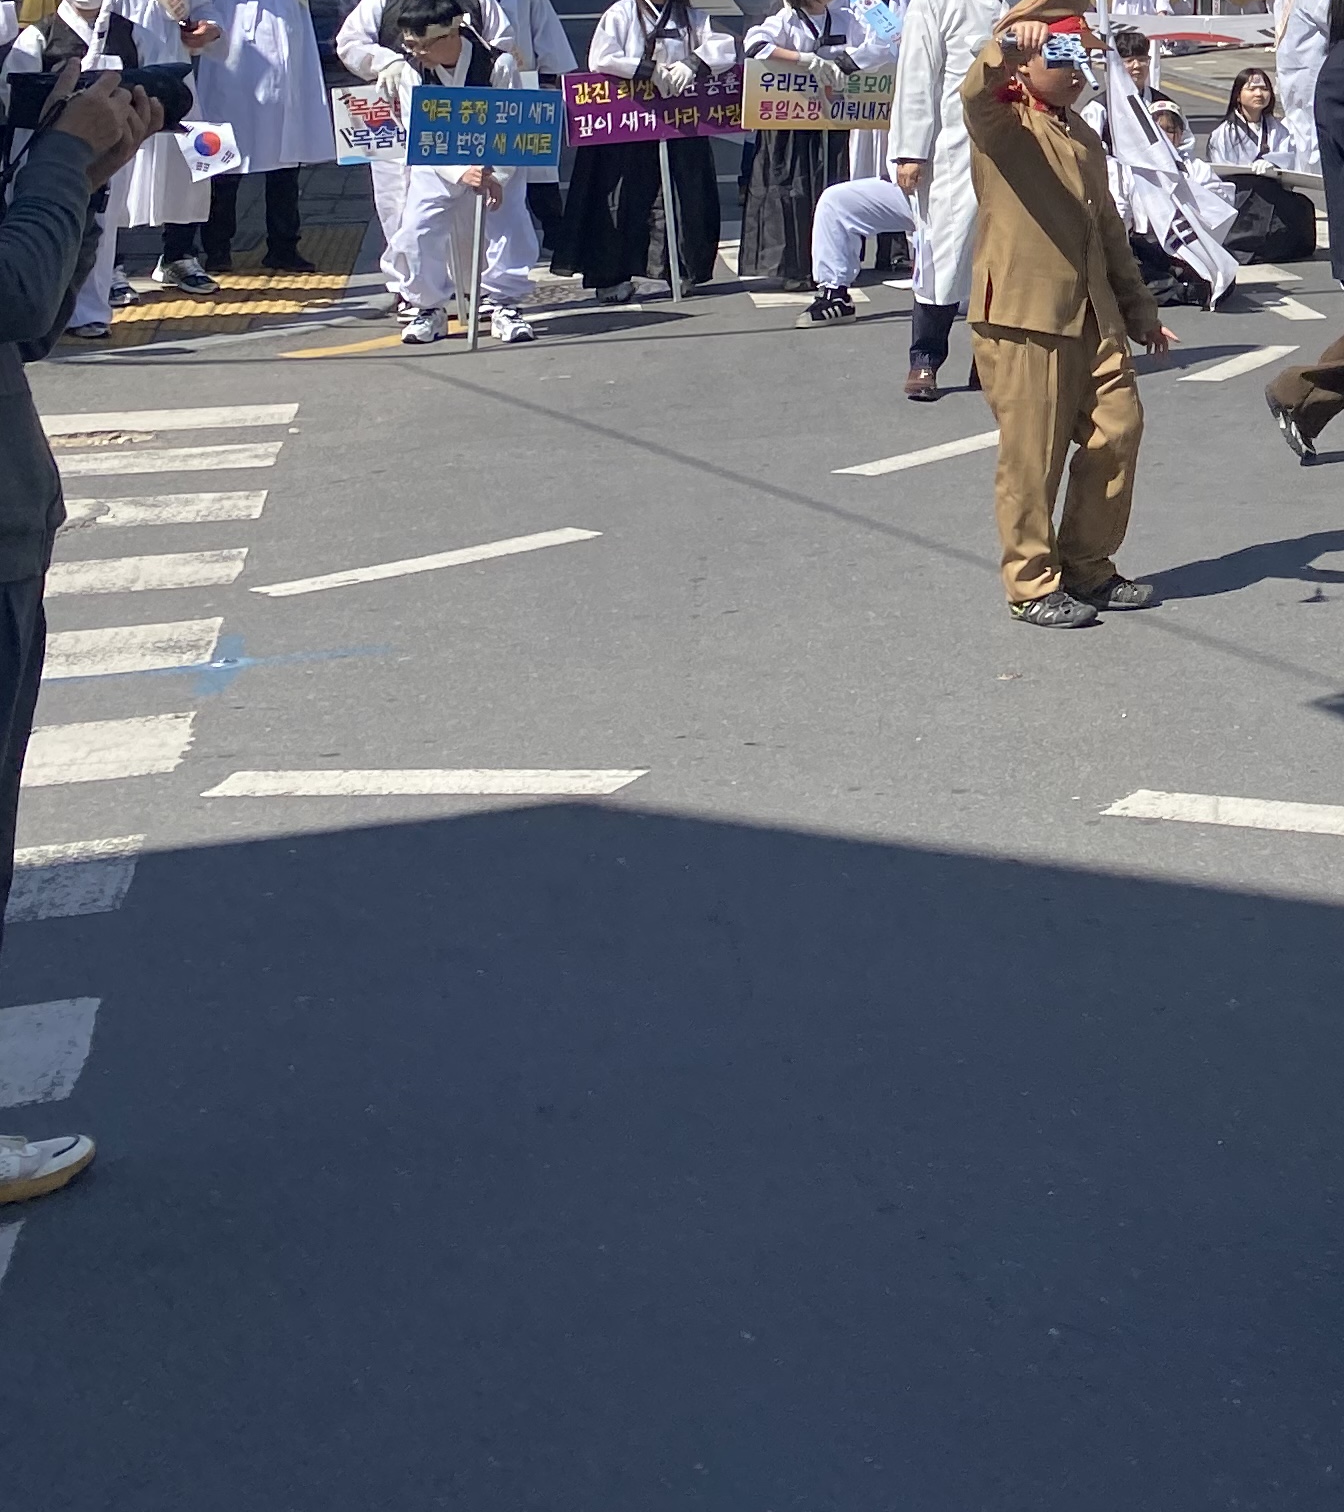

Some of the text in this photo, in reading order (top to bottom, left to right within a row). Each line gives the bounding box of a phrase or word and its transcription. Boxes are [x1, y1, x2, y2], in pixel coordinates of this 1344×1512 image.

[572, 82, 611, 106] 값진
[703, 74, 740, 95] 공훈
[833, 73, 893, 95] 을모아
[421, 99, 555, 125] 애국 충정 깊이 새겨
[572, 104, 743, 138] 깊이 새겨 나라 사랑
[758, 99, 891, 122] 통일소망 이뤄내자
[418, 131, 553, 158] 통일 번영 새 시대로
